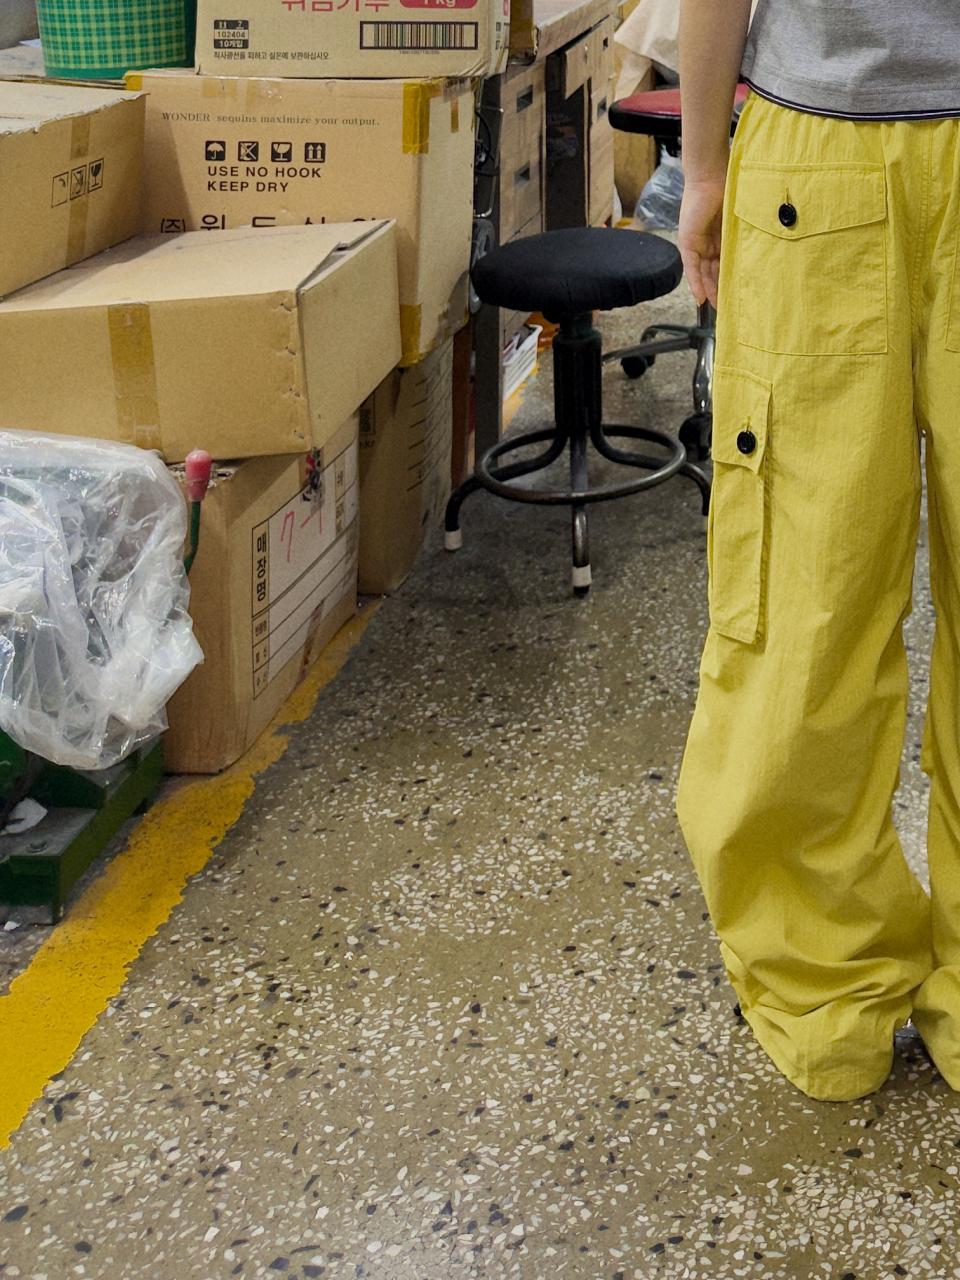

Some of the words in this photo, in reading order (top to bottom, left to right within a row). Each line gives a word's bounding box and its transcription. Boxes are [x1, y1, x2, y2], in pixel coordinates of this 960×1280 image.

[162, 112, 210, 122] WONDER
[217, 115, 257, 125] sequins
[260, 115, 312, 125] maximize
[314, 118, 338, 126] your
[207, 166, 239, 177] USE
[246, 166, 268, 178] NO
[275, 167, 322, 178] HOOK
[207, 181, 249, 192] KEEP
[256, 182, 289, 192] DRY
[256, 532, 267, 602] 매장명
